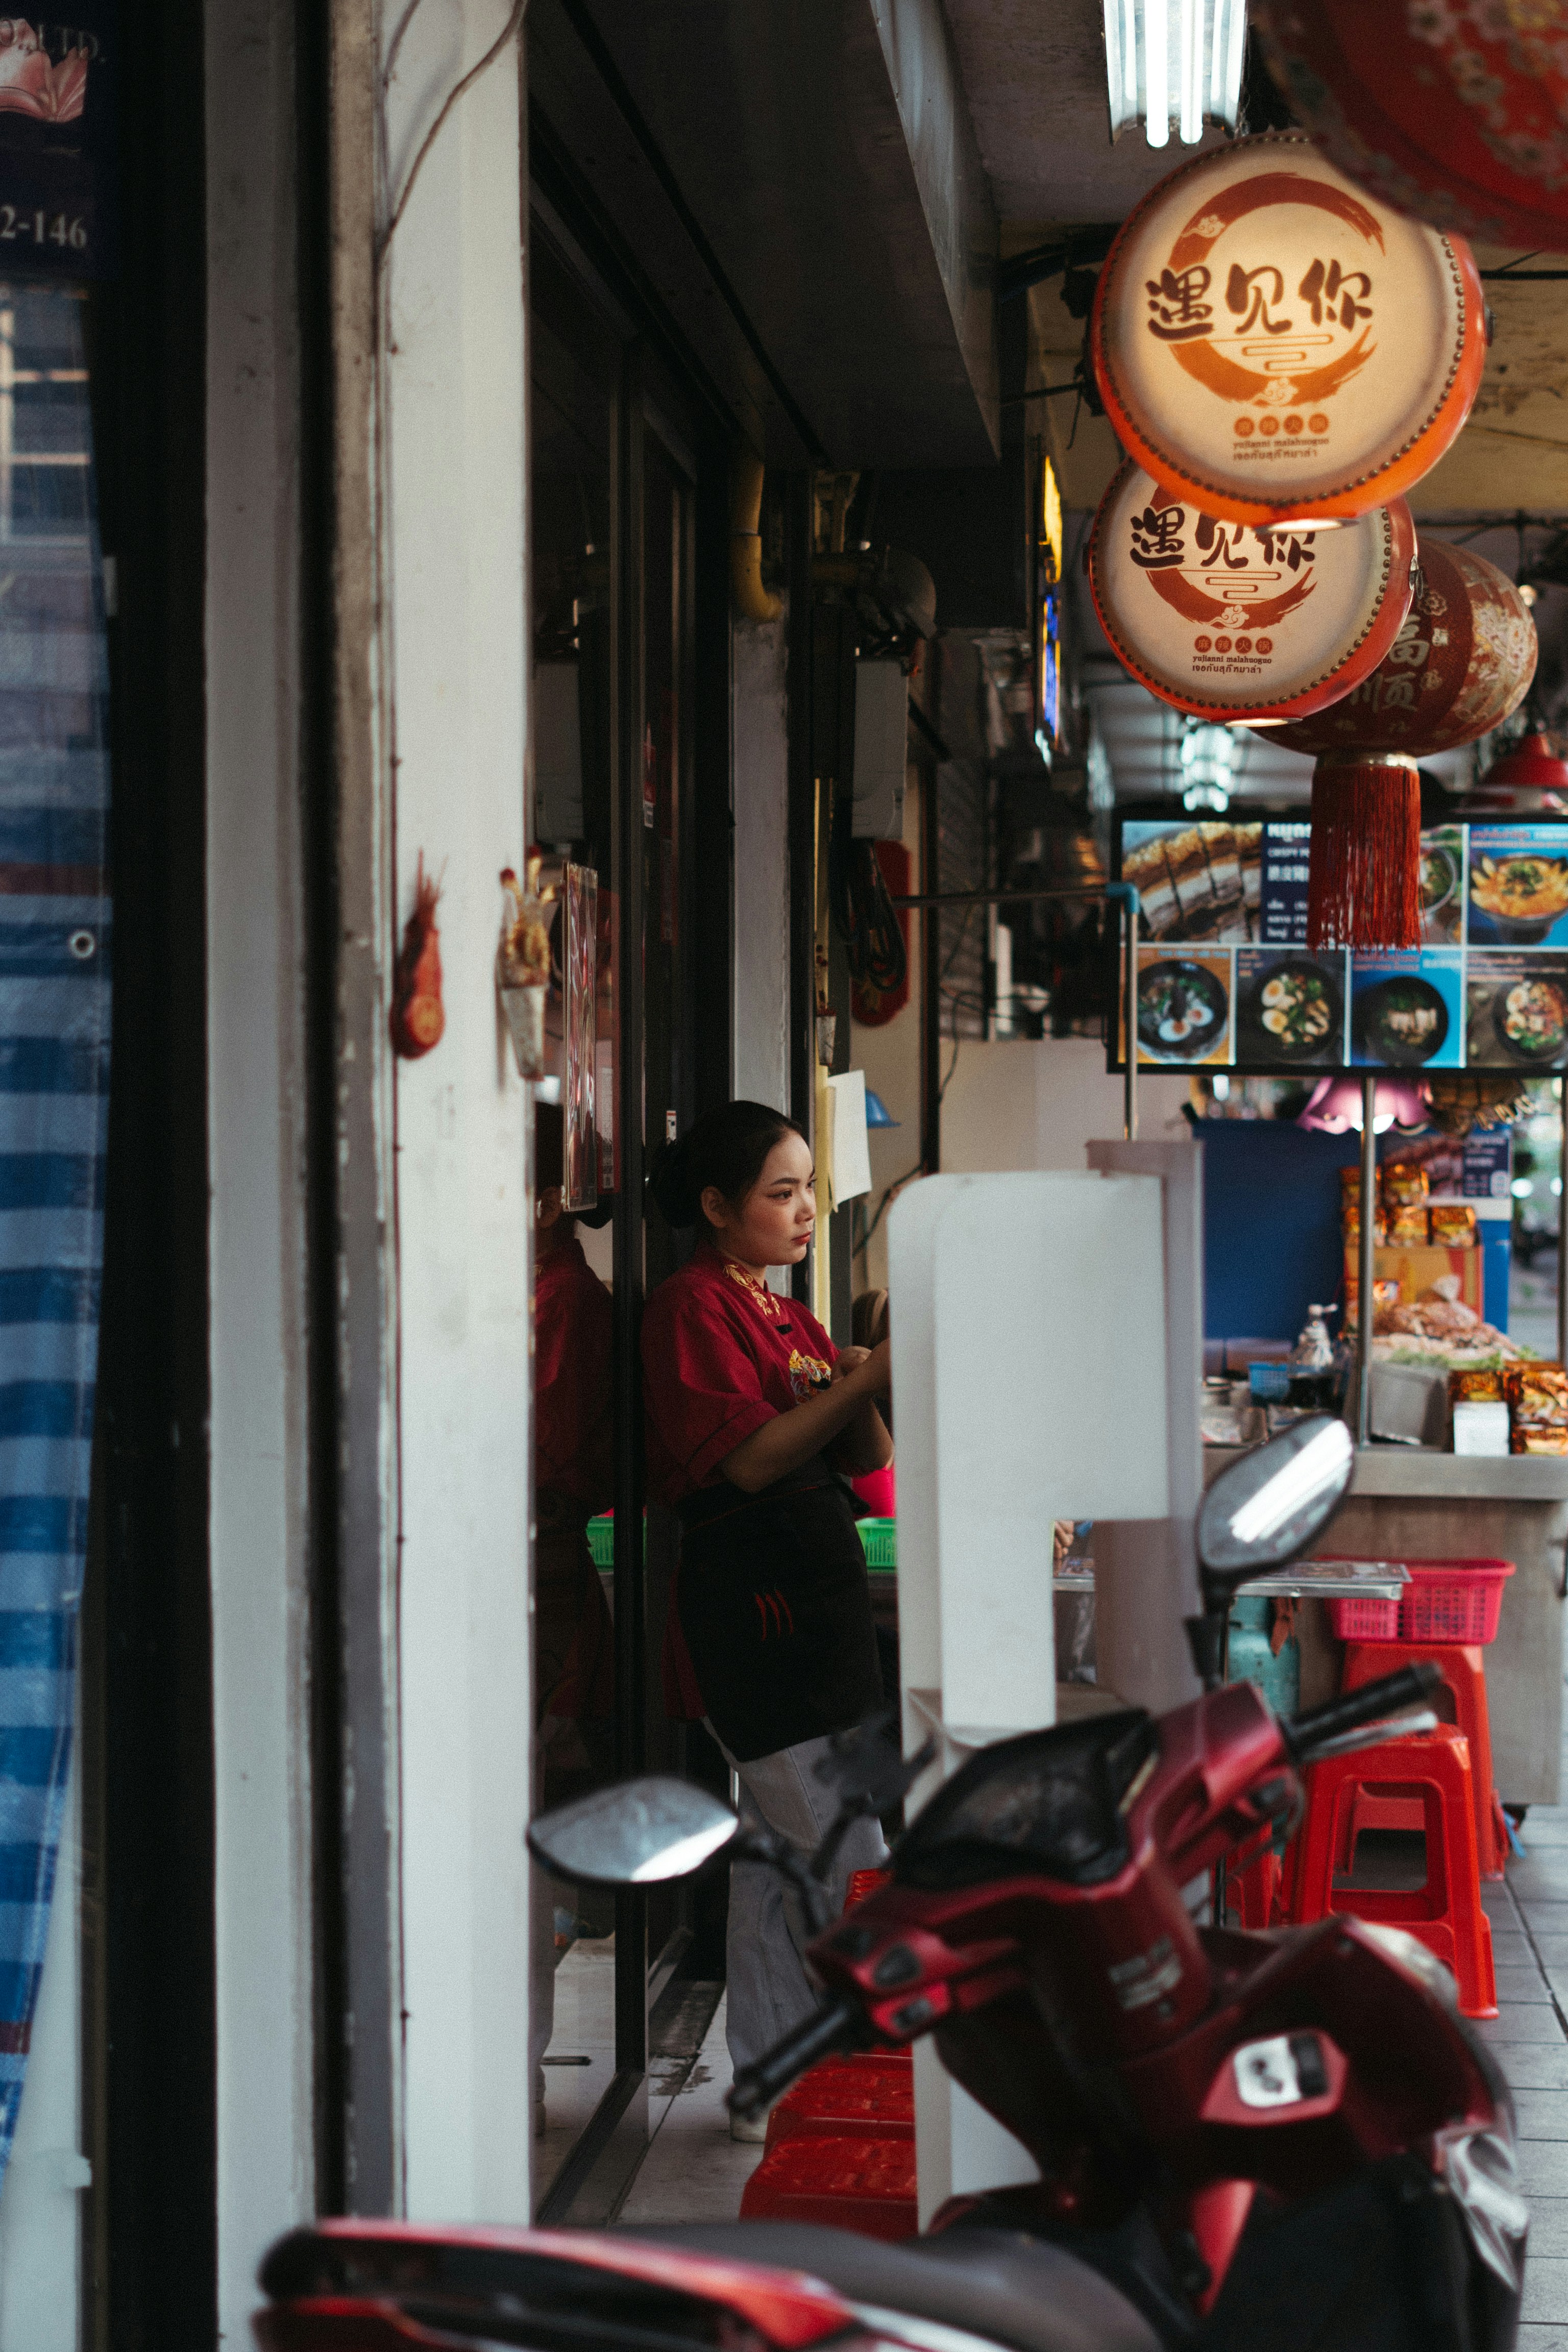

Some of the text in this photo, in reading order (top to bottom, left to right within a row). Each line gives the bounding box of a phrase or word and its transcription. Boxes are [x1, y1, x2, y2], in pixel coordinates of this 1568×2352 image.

[1145, 258, 1373, 341] 遇见你
[1227, 656, 1272, 664] malahuoguo
